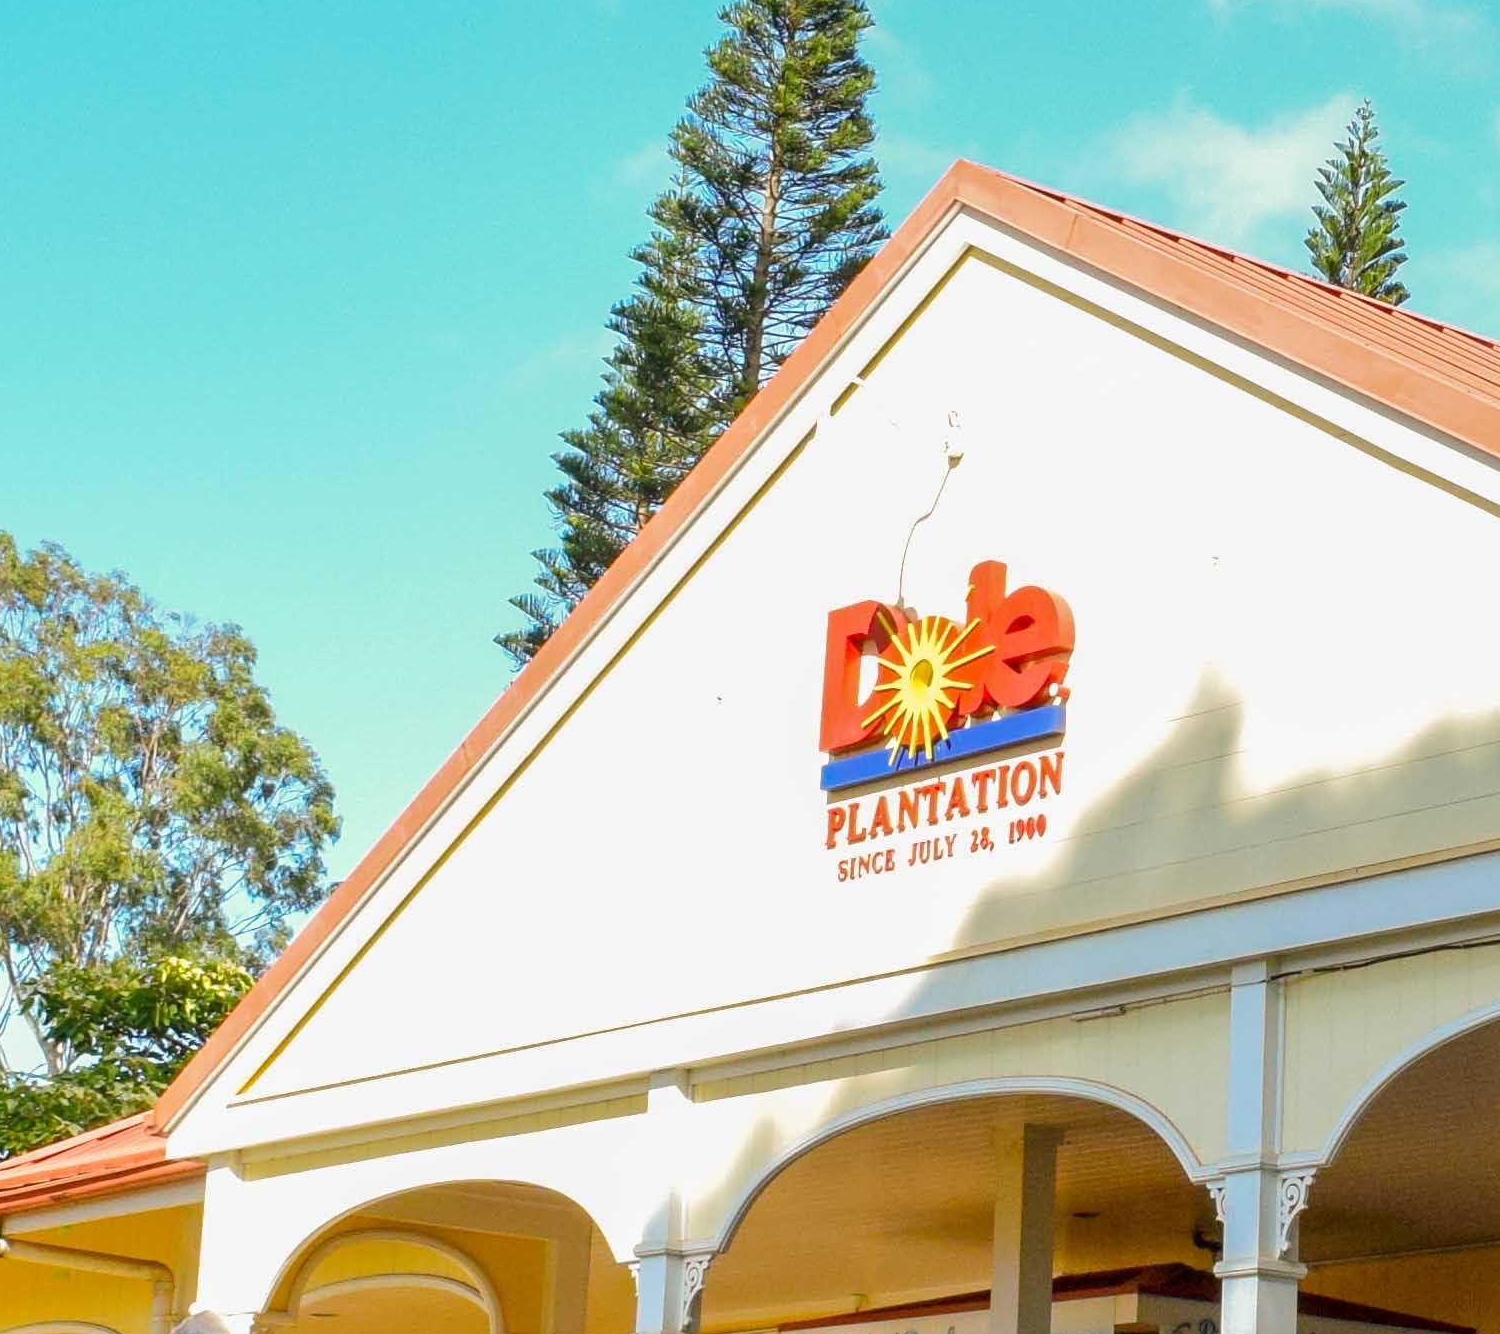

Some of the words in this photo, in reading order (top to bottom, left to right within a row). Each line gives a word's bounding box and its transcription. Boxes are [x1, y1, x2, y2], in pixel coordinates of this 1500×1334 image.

[819, 560, 1075, 752] Dole
[825, 751, 1065, 850] PLANTATION
[837, 849, 896, 883] SINCE
[908, 833, 958, 867] JULY
[970, 826, 995, 853] 28,
